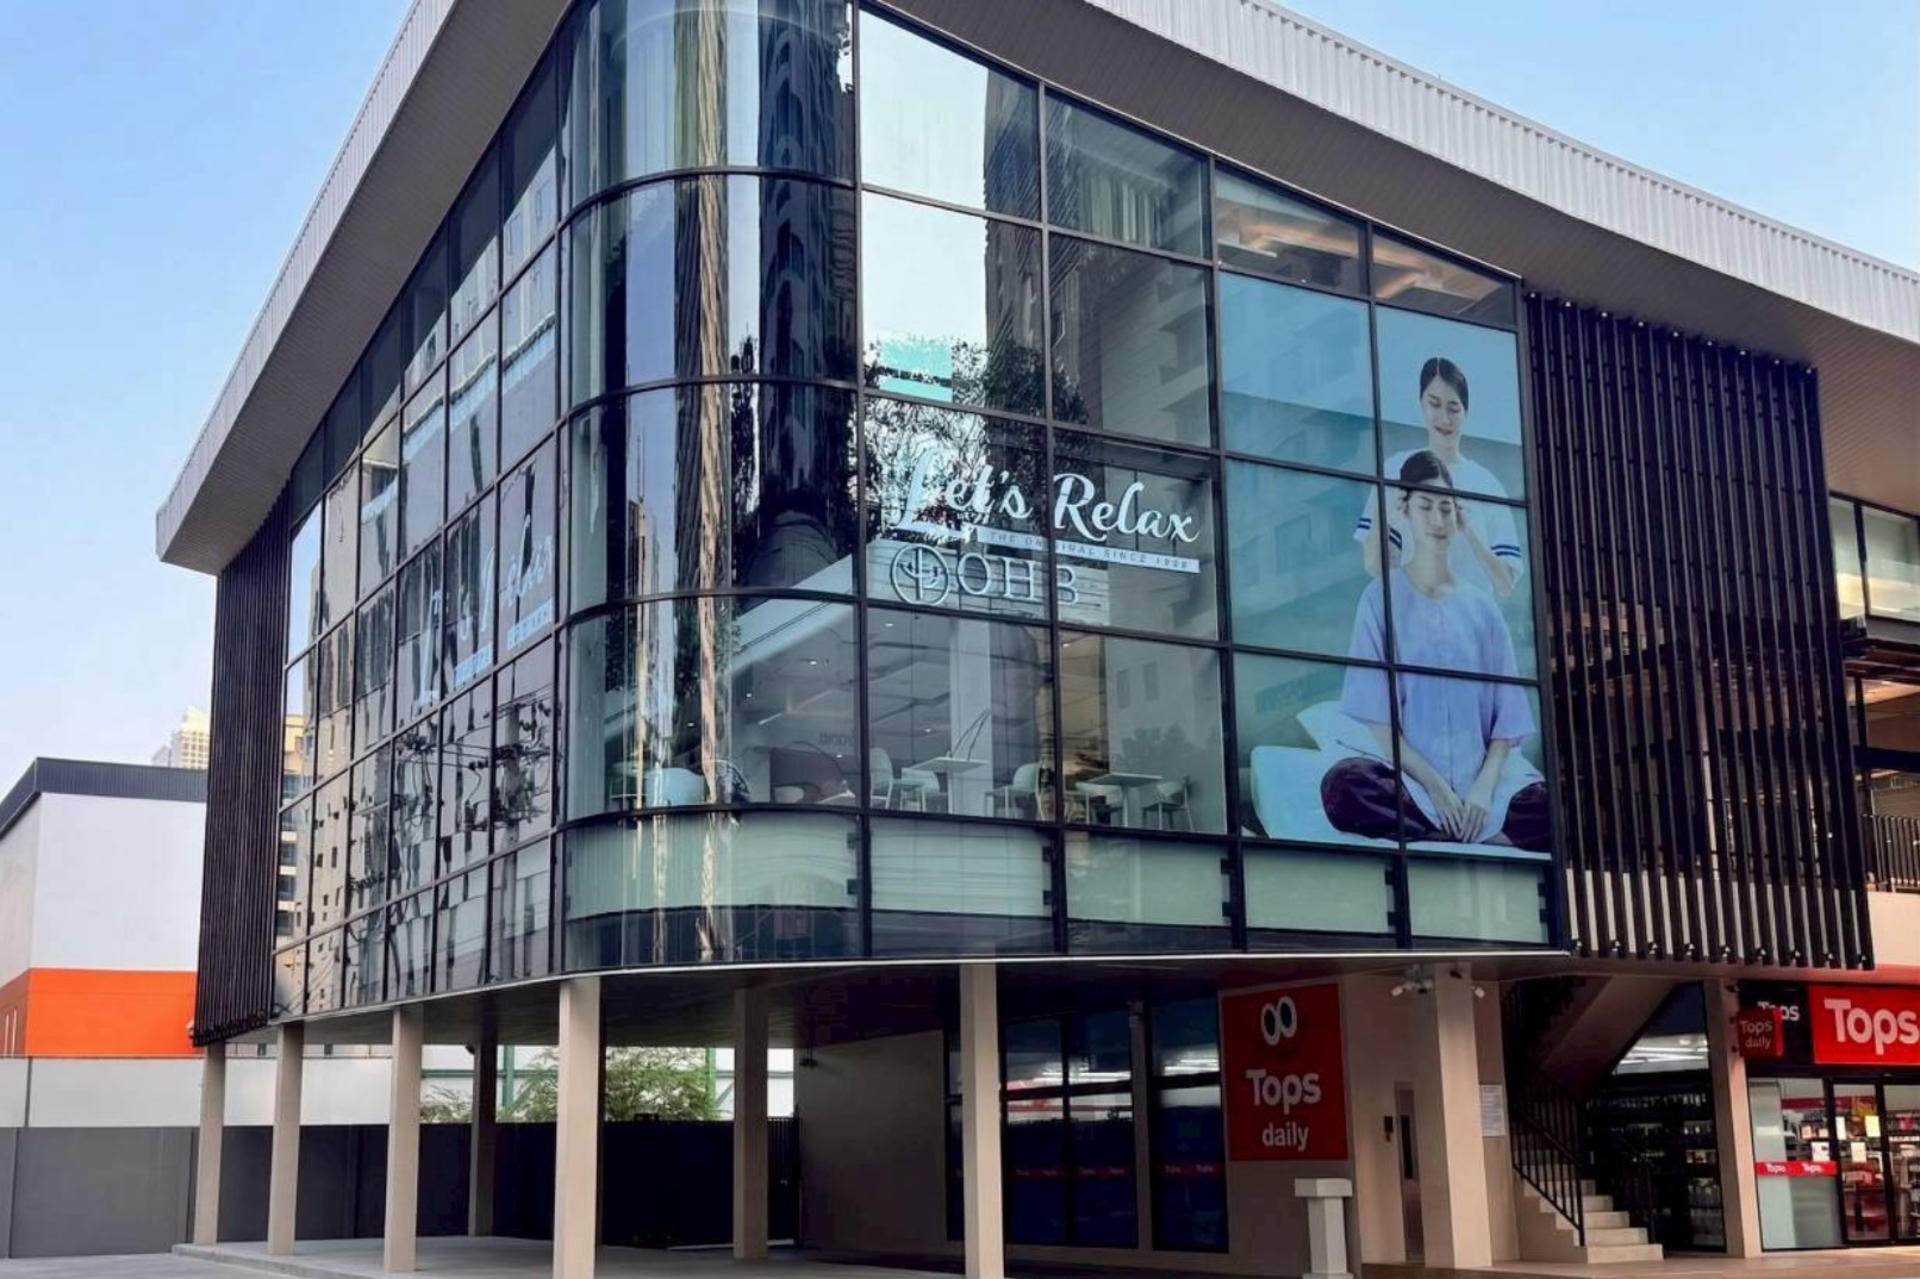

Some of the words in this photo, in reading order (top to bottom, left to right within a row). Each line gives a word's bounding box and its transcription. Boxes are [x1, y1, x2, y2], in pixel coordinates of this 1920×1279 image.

[1053, 473, 1199, 543] Relax
[1740, 1020, 1773, 1036] Tops
[1745, 1036, 1771, 1050] daily
[1824, 997, 1920, 1056] Tops
[1245, 1068, 1322, 1116] Tops
[1262, 1121, 1309, 1152] daily
